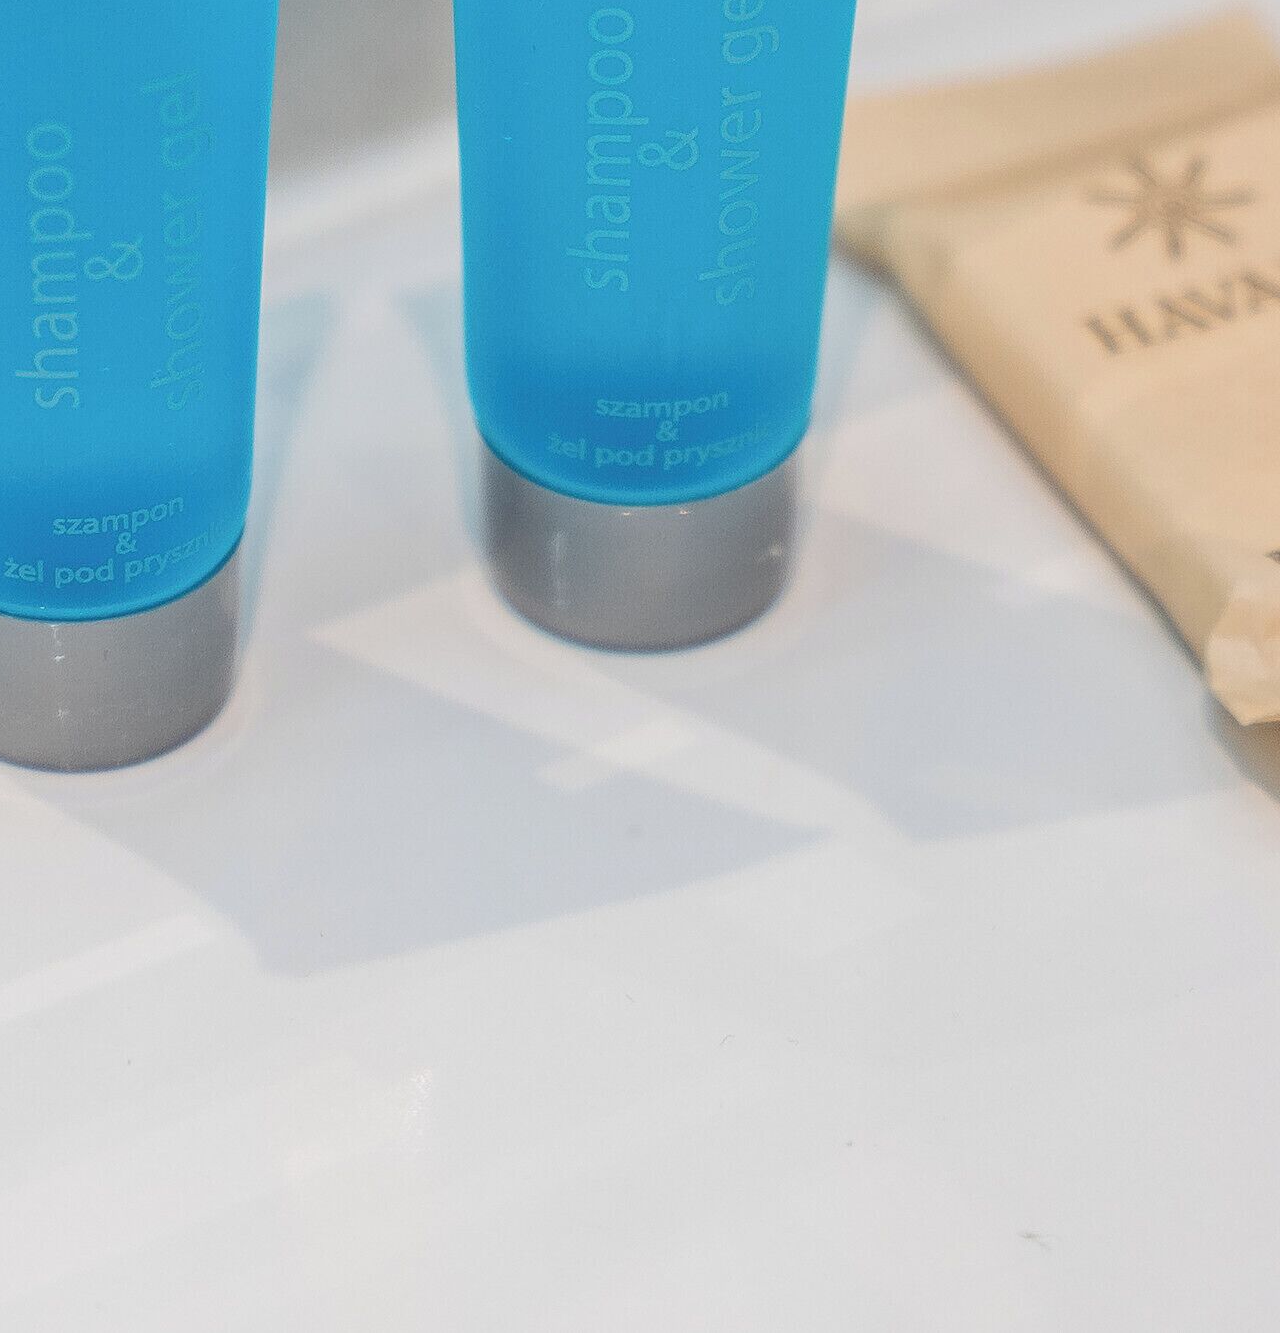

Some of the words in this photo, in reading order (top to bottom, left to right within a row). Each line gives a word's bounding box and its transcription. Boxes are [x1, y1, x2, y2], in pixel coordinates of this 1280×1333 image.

[141, 70, 216, 170] gel
[566, 8, 649, 291] shampoo
[636, 126, 700, 170] &
[697, 86, 762, 305] shower
[16, 121, 94, 409] shampoo
[82, 234, 144, 281] &
[147, 190, 206, 411] shower
[596, 390, 728, 423] szampon
[547, 433, 587, 459] żel
[595, 445, 654, 467] pod
[656, 420, 680, 441] &
[52, 496, 184, 535] szampon
[115, 532, 137, 554] &
[3, 557, 44, 583] żel
[54, 558, 114, 588] pod
